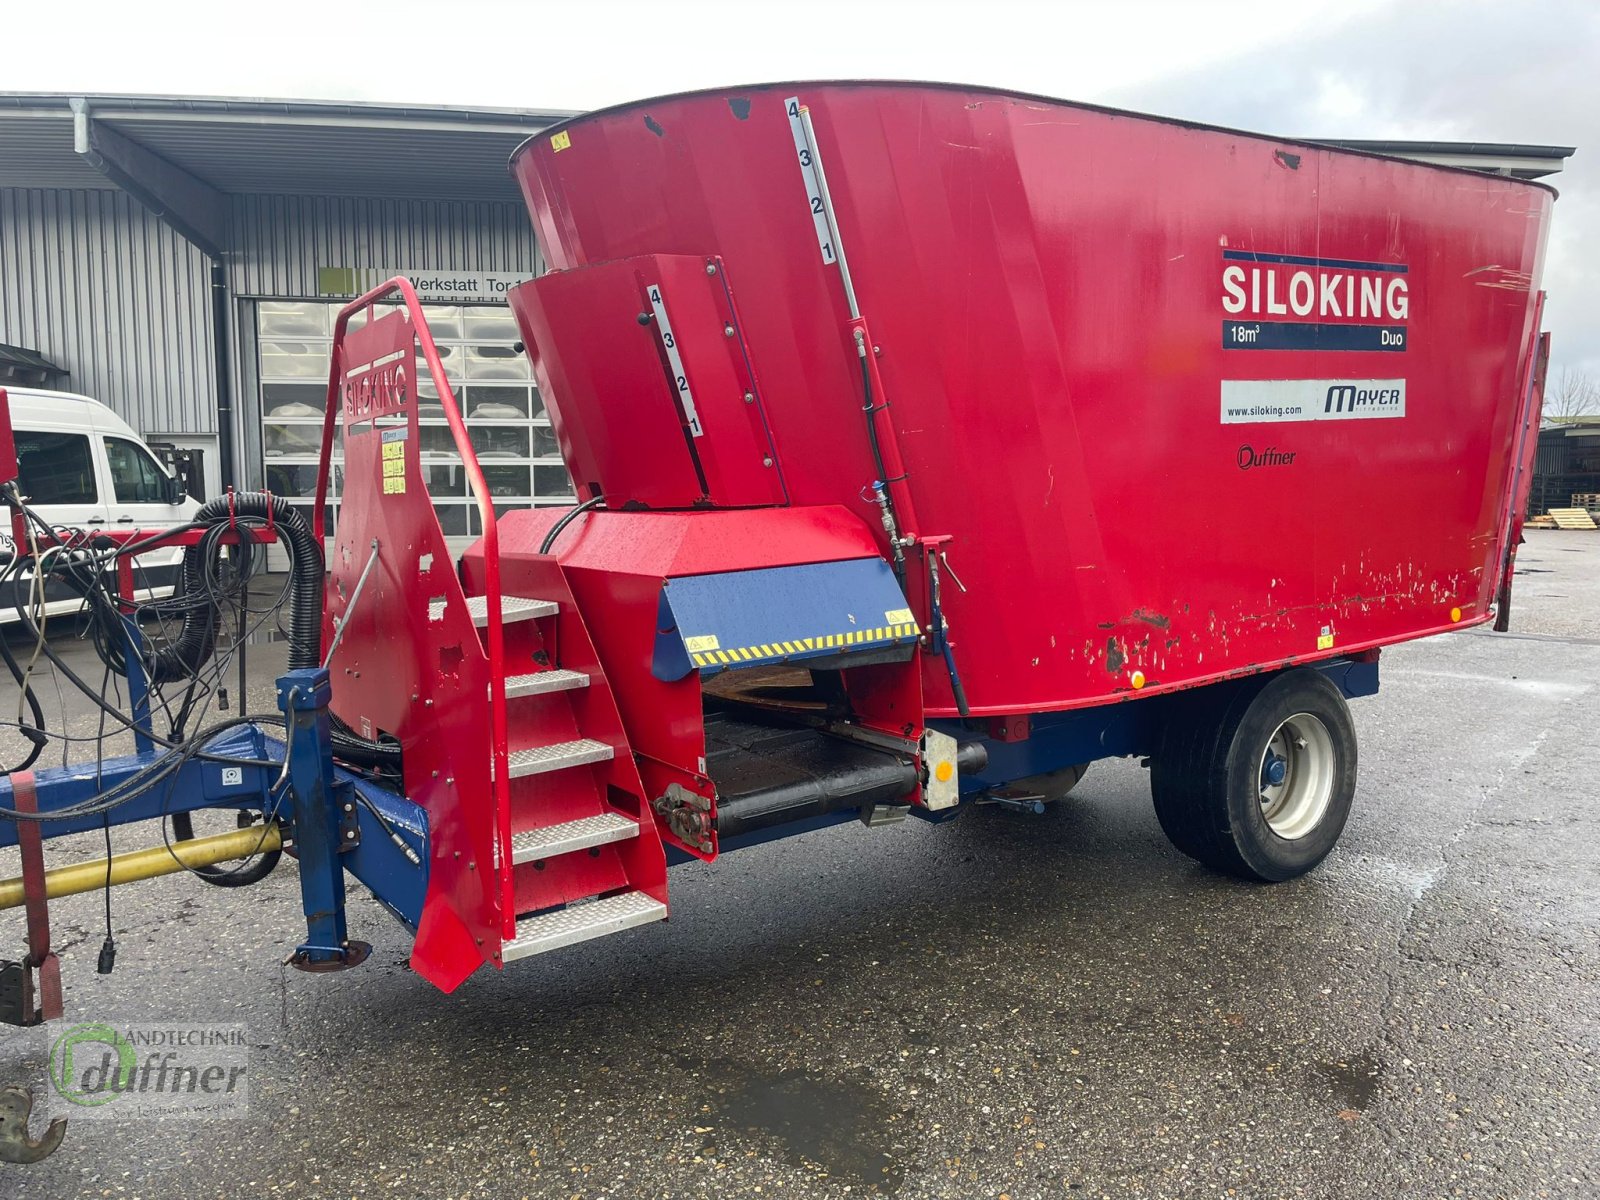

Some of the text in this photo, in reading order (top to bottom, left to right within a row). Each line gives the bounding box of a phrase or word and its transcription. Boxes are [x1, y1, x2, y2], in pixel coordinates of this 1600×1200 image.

[788, 102, 832, 258] 4 3 2 1
[486, 279, 511, 292] Tor
[1222, 266, 1408, 320] SILOKING
[651, 289, 699, 432] 4 3 2 1
[1381, 330, 1403, 346] Duo
[347, 365, 407, 417] SILOKING
[1227, 406, 1302, 417] www.siloking.com
